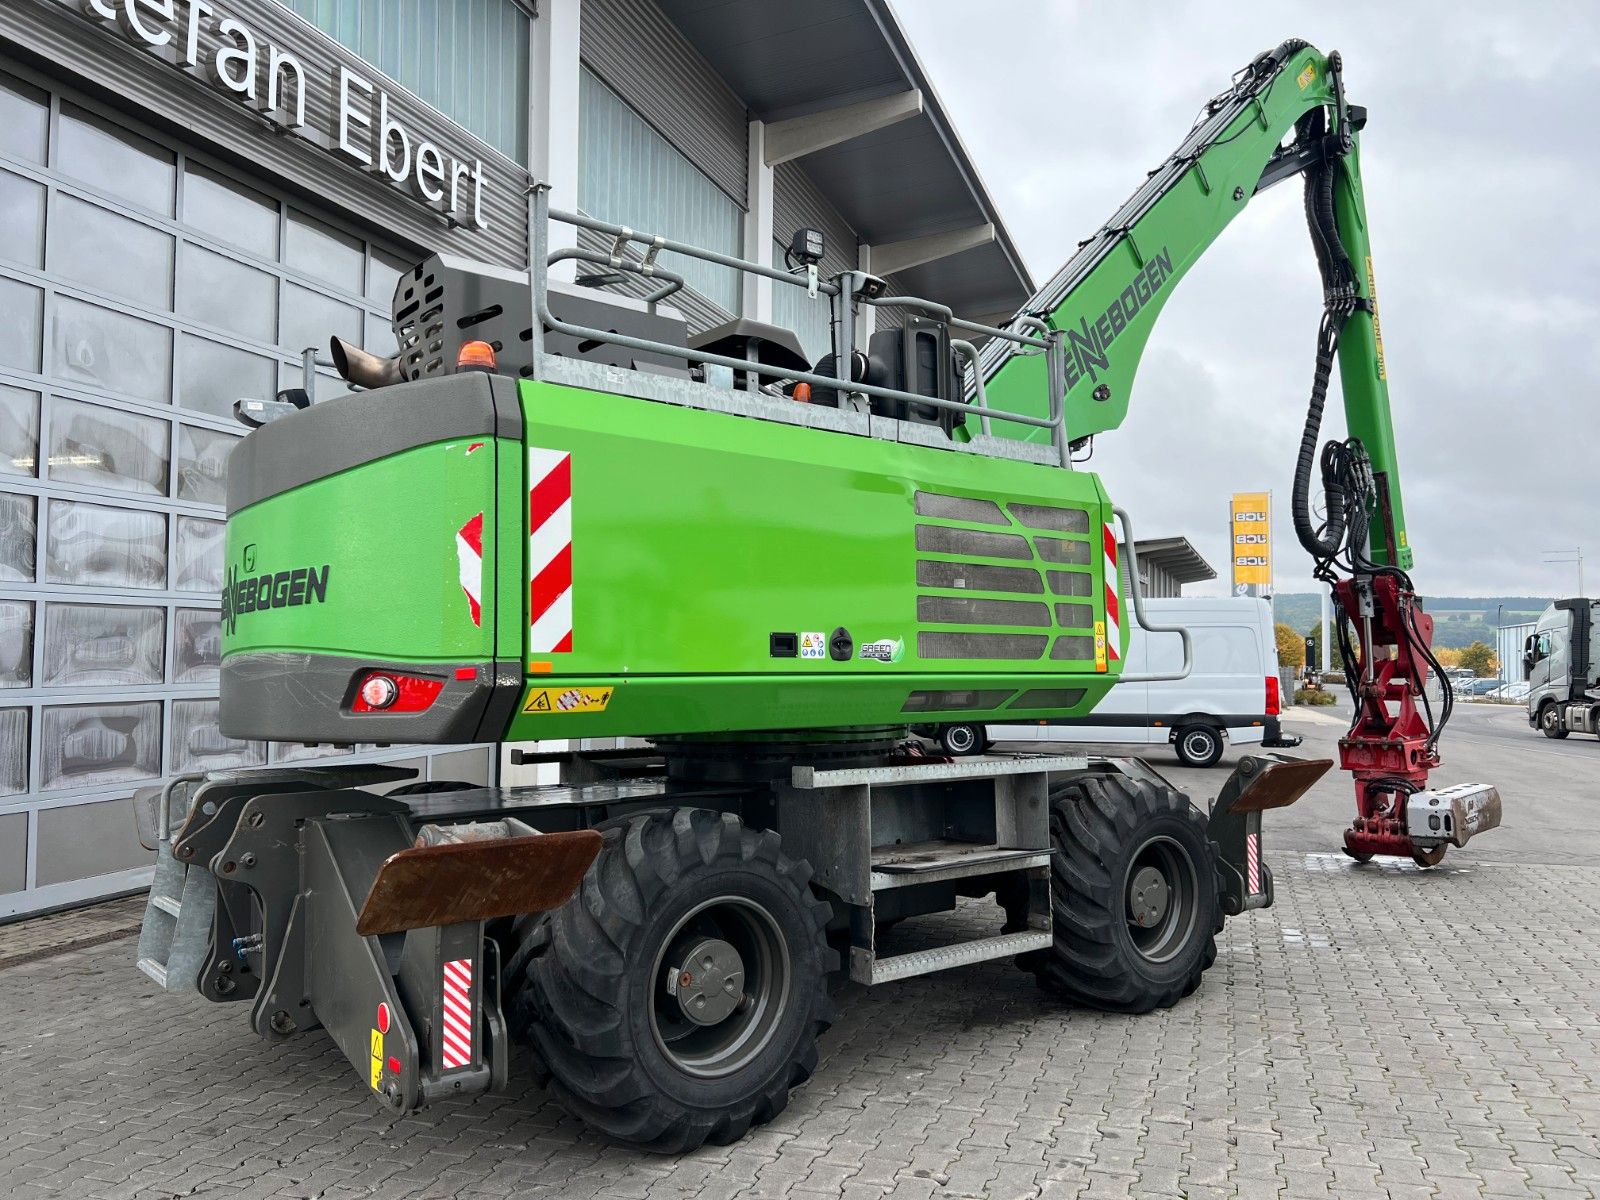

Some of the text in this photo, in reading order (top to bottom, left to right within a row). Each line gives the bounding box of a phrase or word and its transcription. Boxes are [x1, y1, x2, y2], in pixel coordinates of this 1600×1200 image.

[90, 0, 488, 229] efan Ebert
[1064, 246, 1174, 396] ENNEBOGEN
[1373, 309, 1383, 347] ZONE
[862, 644, 891, 652] GREEN
